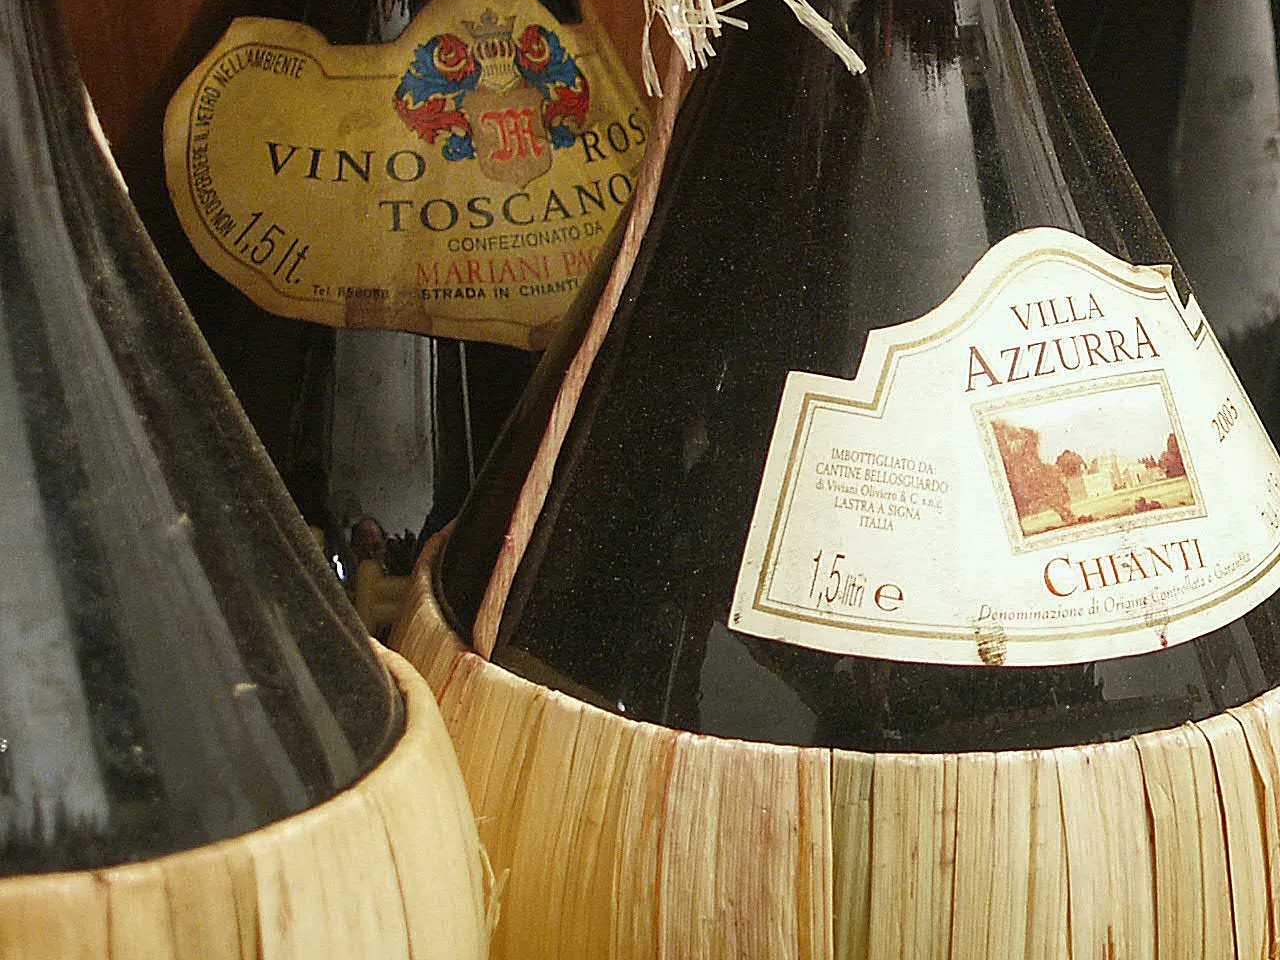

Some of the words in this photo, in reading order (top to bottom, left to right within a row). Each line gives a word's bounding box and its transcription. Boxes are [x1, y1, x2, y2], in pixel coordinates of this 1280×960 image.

[264, 140, 428, 185] VINO
[580, 112, 647, 165] ROS
[379, 171, 633, 233] TOSCANO
[447, 225, 581, 252] CONFEZIONATO
[585, 221, 604, 238] DA
[414, 254, 551, 289] MARIANI
[421, 286, 487, 301] STRADA
[494, 287, 511, 299] IN
[519, 278, 581, 298] CHIANTI
[1008, 292, 1106, 332] VILLA
[964, 316, 1162, 393] AZZURRA
[831, 448, 916, 471] IMBOTTIGLIATO
[815, 461, 866, 480] CANTINE
[863, 468, 949, 495] BELLOSGUARDO
[833, 495, 875, 514] LASTRA
[877, 503, 886, 515] A
[887, 505, 922, 521] SIGNA
[859, 514, 895, 532] ITALIA
[1043, 537, 1208, 598] CHIANTI
[977, 602, 1084, 624] Denominazione
[1087, 597, 1101, 616] di
[1103, 594, 1150, 617] Origine
